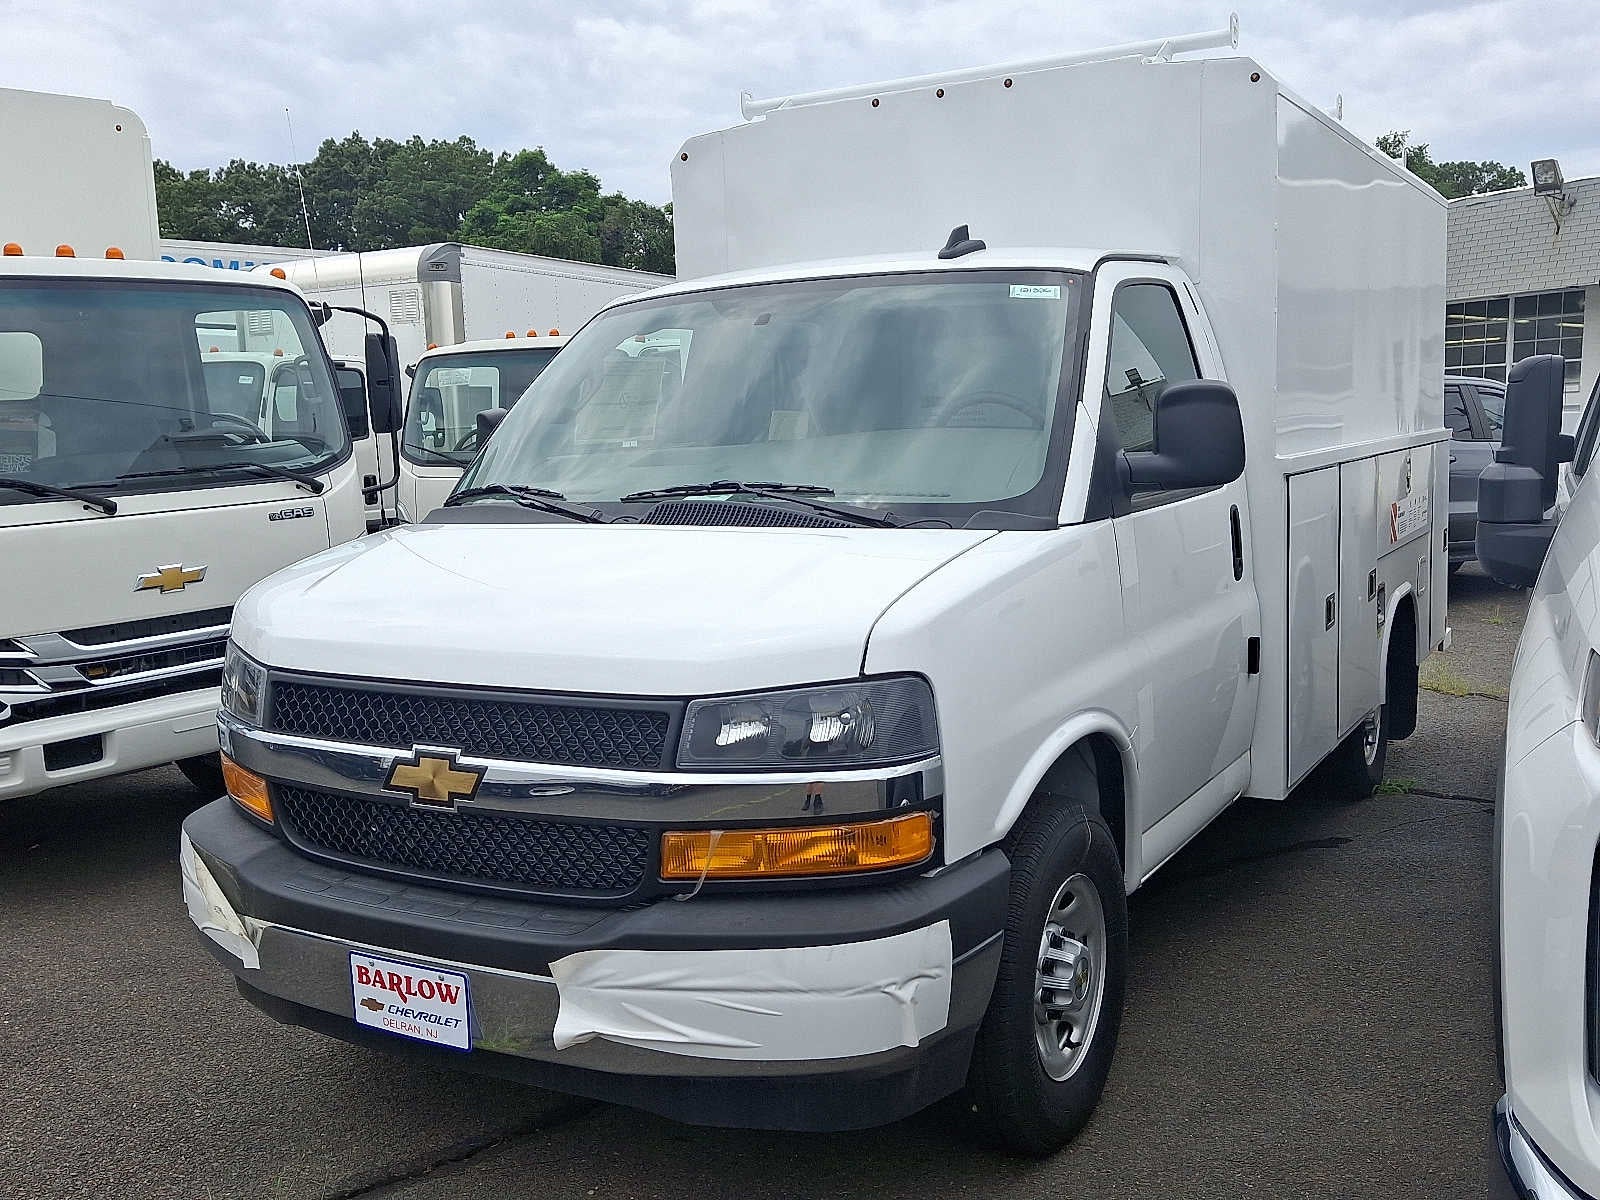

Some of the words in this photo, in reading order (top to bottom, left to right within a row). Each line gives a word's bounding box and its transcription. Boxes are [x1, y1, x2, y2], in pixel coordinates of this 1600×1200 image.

[280, 507, 314, 519] GAS
[356, 964, 460, 1005] BARLOW
[387, 1004, 462, 1029] CHEVROLET
[426, 1027, 438, 1039] NJ
